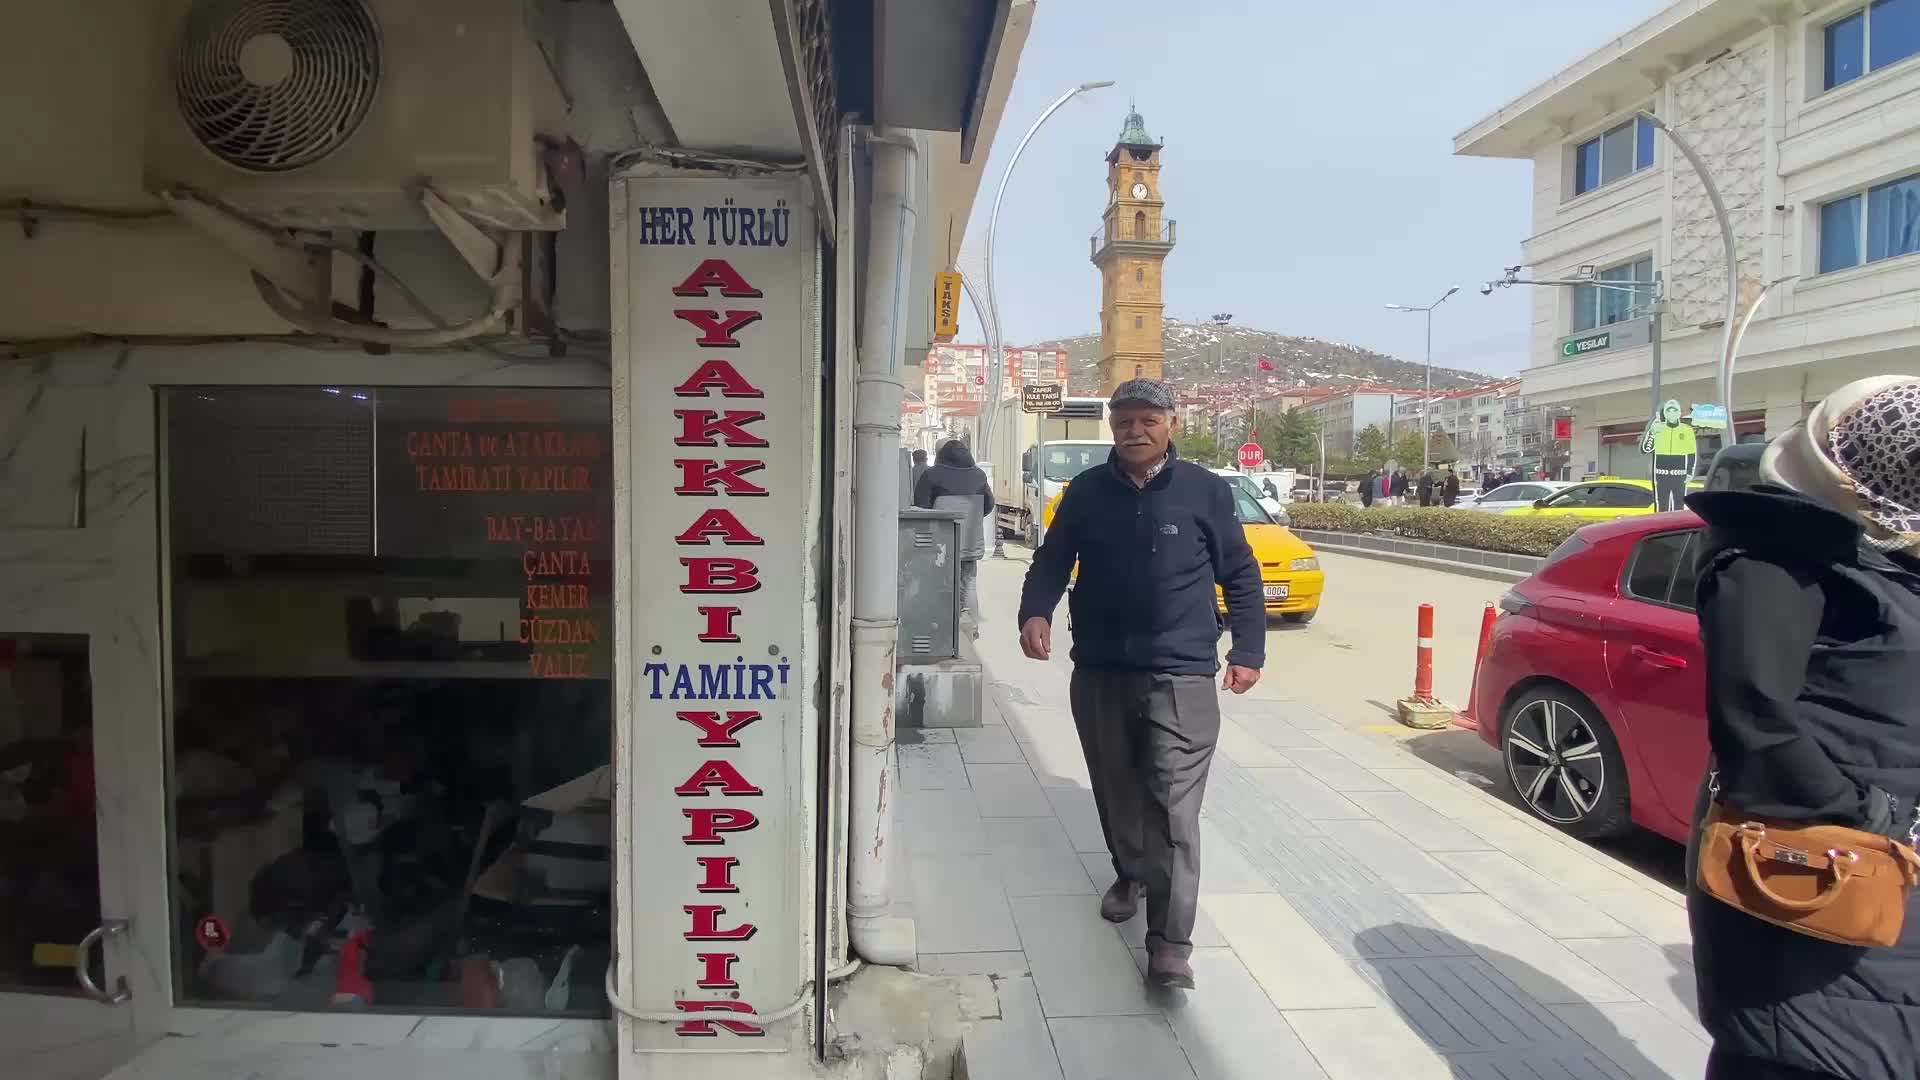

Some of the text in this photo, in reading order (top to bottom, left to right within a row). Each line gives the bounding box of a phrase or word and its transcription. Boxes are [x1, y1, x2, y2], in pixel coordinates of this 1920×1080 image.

[639, 197, 790, 247] HER TÜRLÜ
[672, 259, 769, 643] AYAKKABI
[1240, 450, 1261, 460] DUR
[523, 551, 592, 580] ÇANTA
[527, 585, 590, 608] KEMER
[1266, 586, 1286, 596] 0004
[674, 711, 766, 1036] YAPILIR
